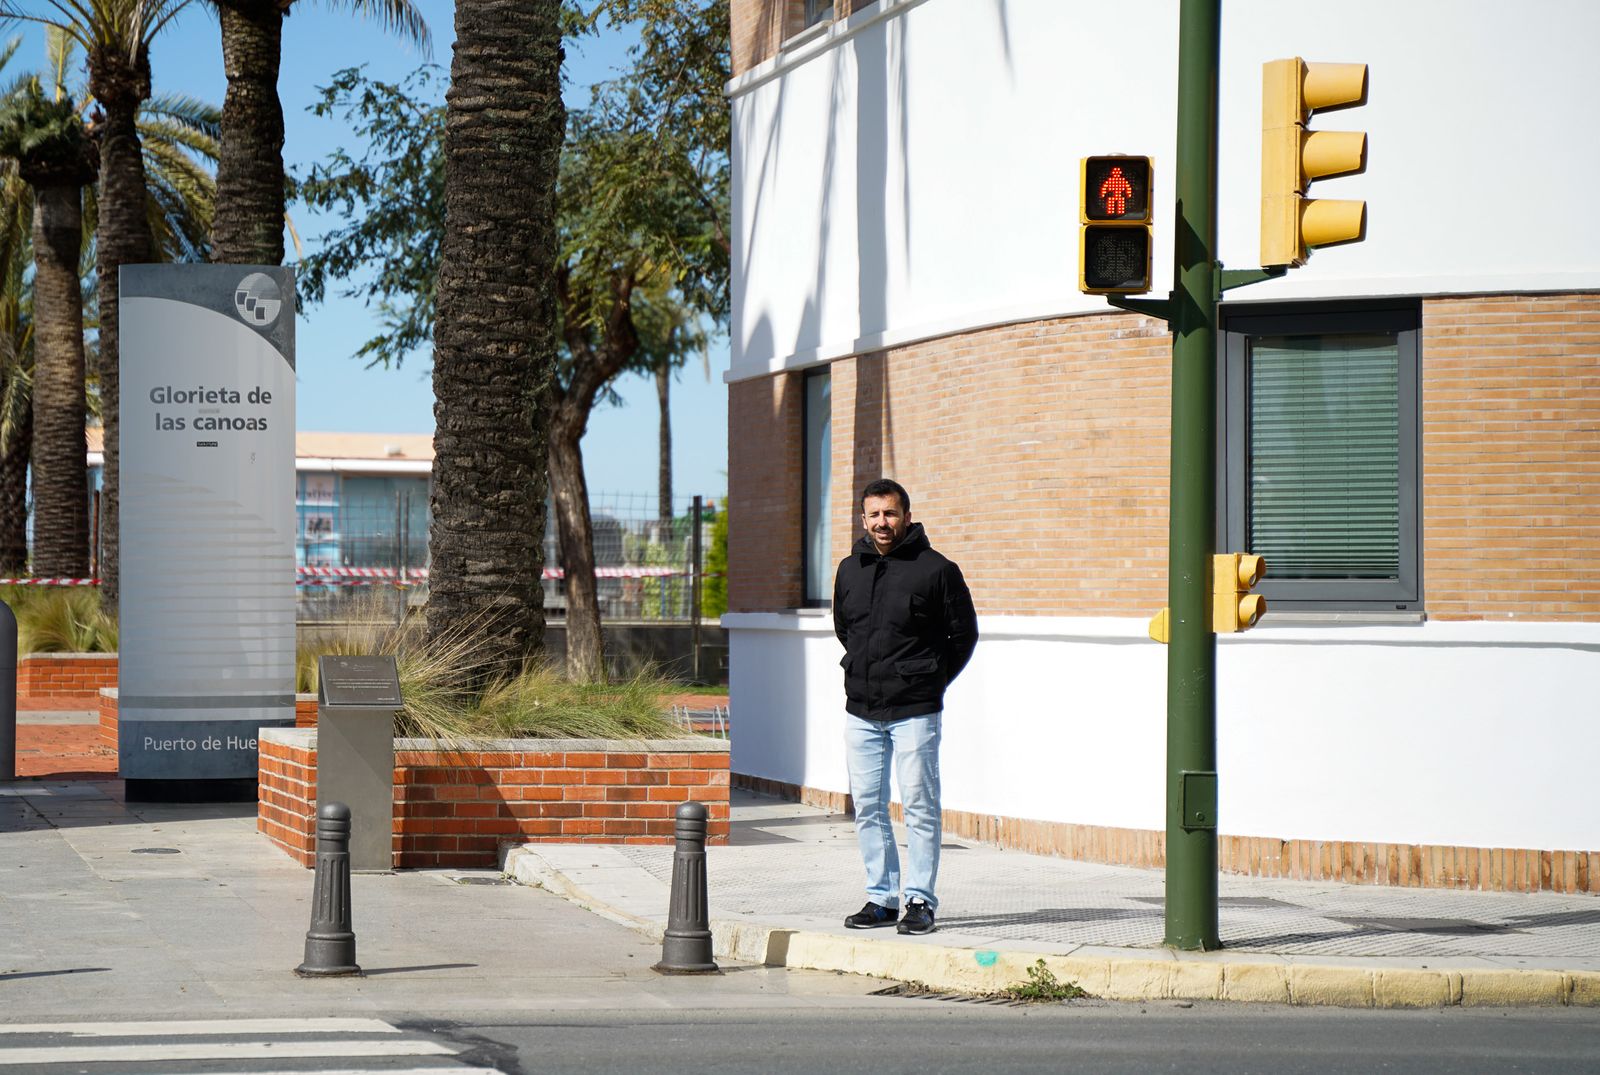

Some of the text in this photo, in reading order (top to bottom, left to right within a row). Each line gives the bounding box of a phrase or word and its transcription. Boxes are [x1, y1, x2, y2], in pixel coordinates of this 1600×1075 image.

[149, 385, 272, 405] Glorieta de
[155, 412, 268, 431] las canoas
[144, 736, 197, 751] Puerto
[201, 735, 222, 751] de
